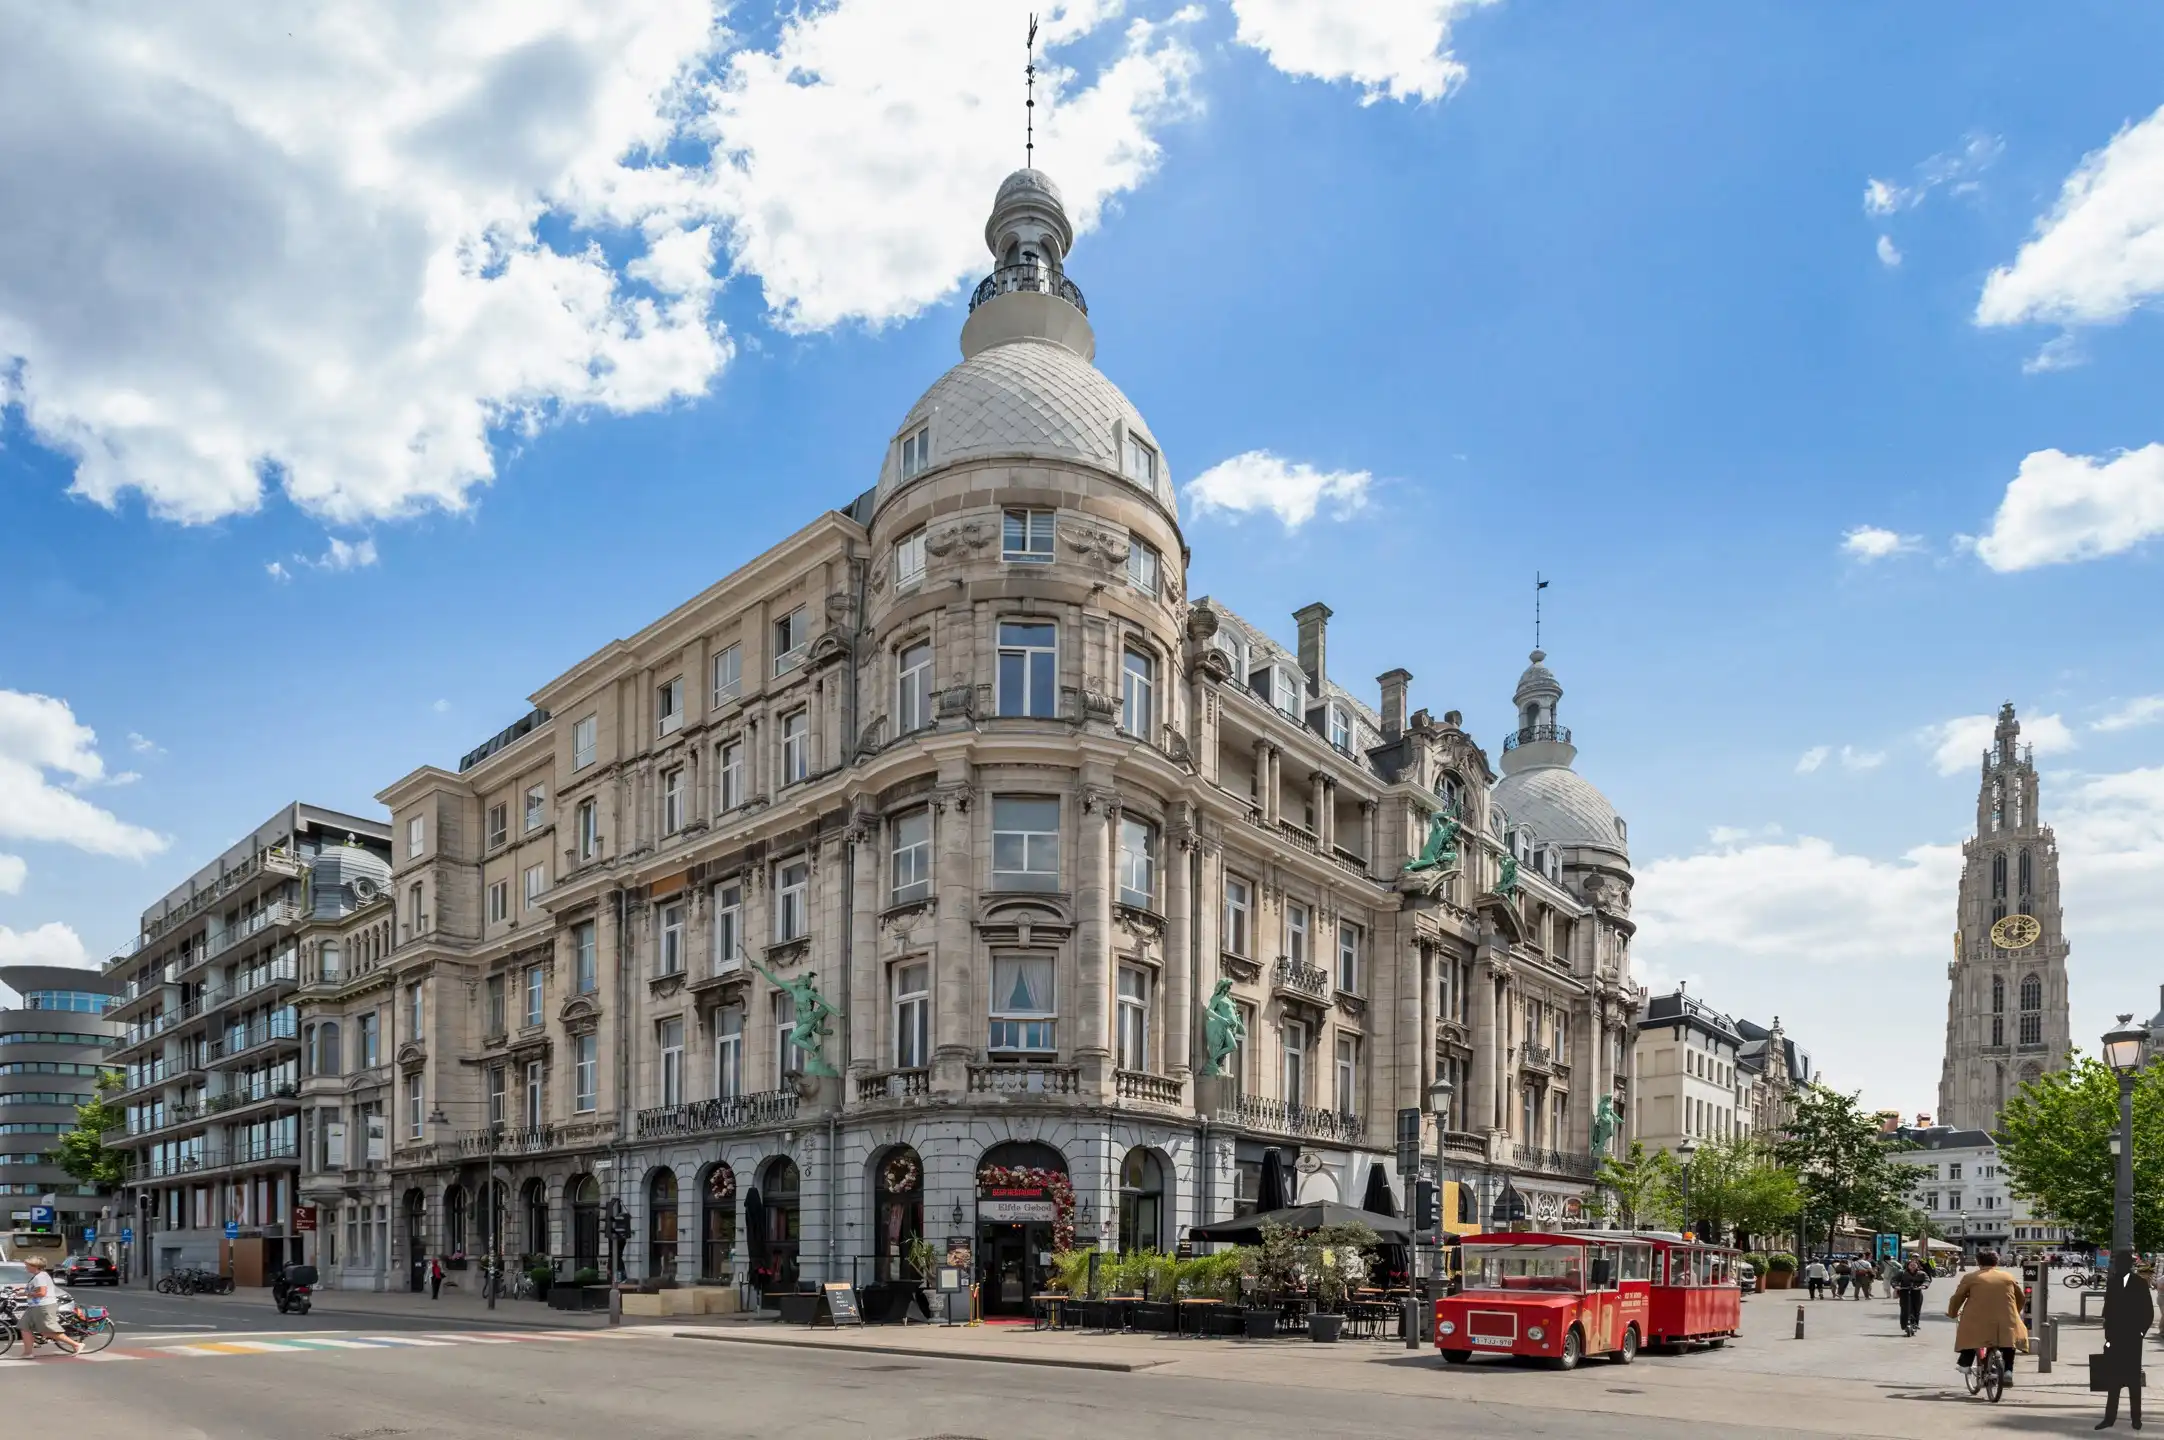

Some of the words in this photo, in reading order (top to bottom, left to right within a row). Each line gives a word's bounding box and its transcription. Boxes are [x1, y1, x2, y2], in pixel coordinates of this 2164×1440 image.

[998, 1203, 1021, 1211] Elfde
[1023, 1203, 1052, 1211] Gebod
[32, 1207, 48, 1220] P
